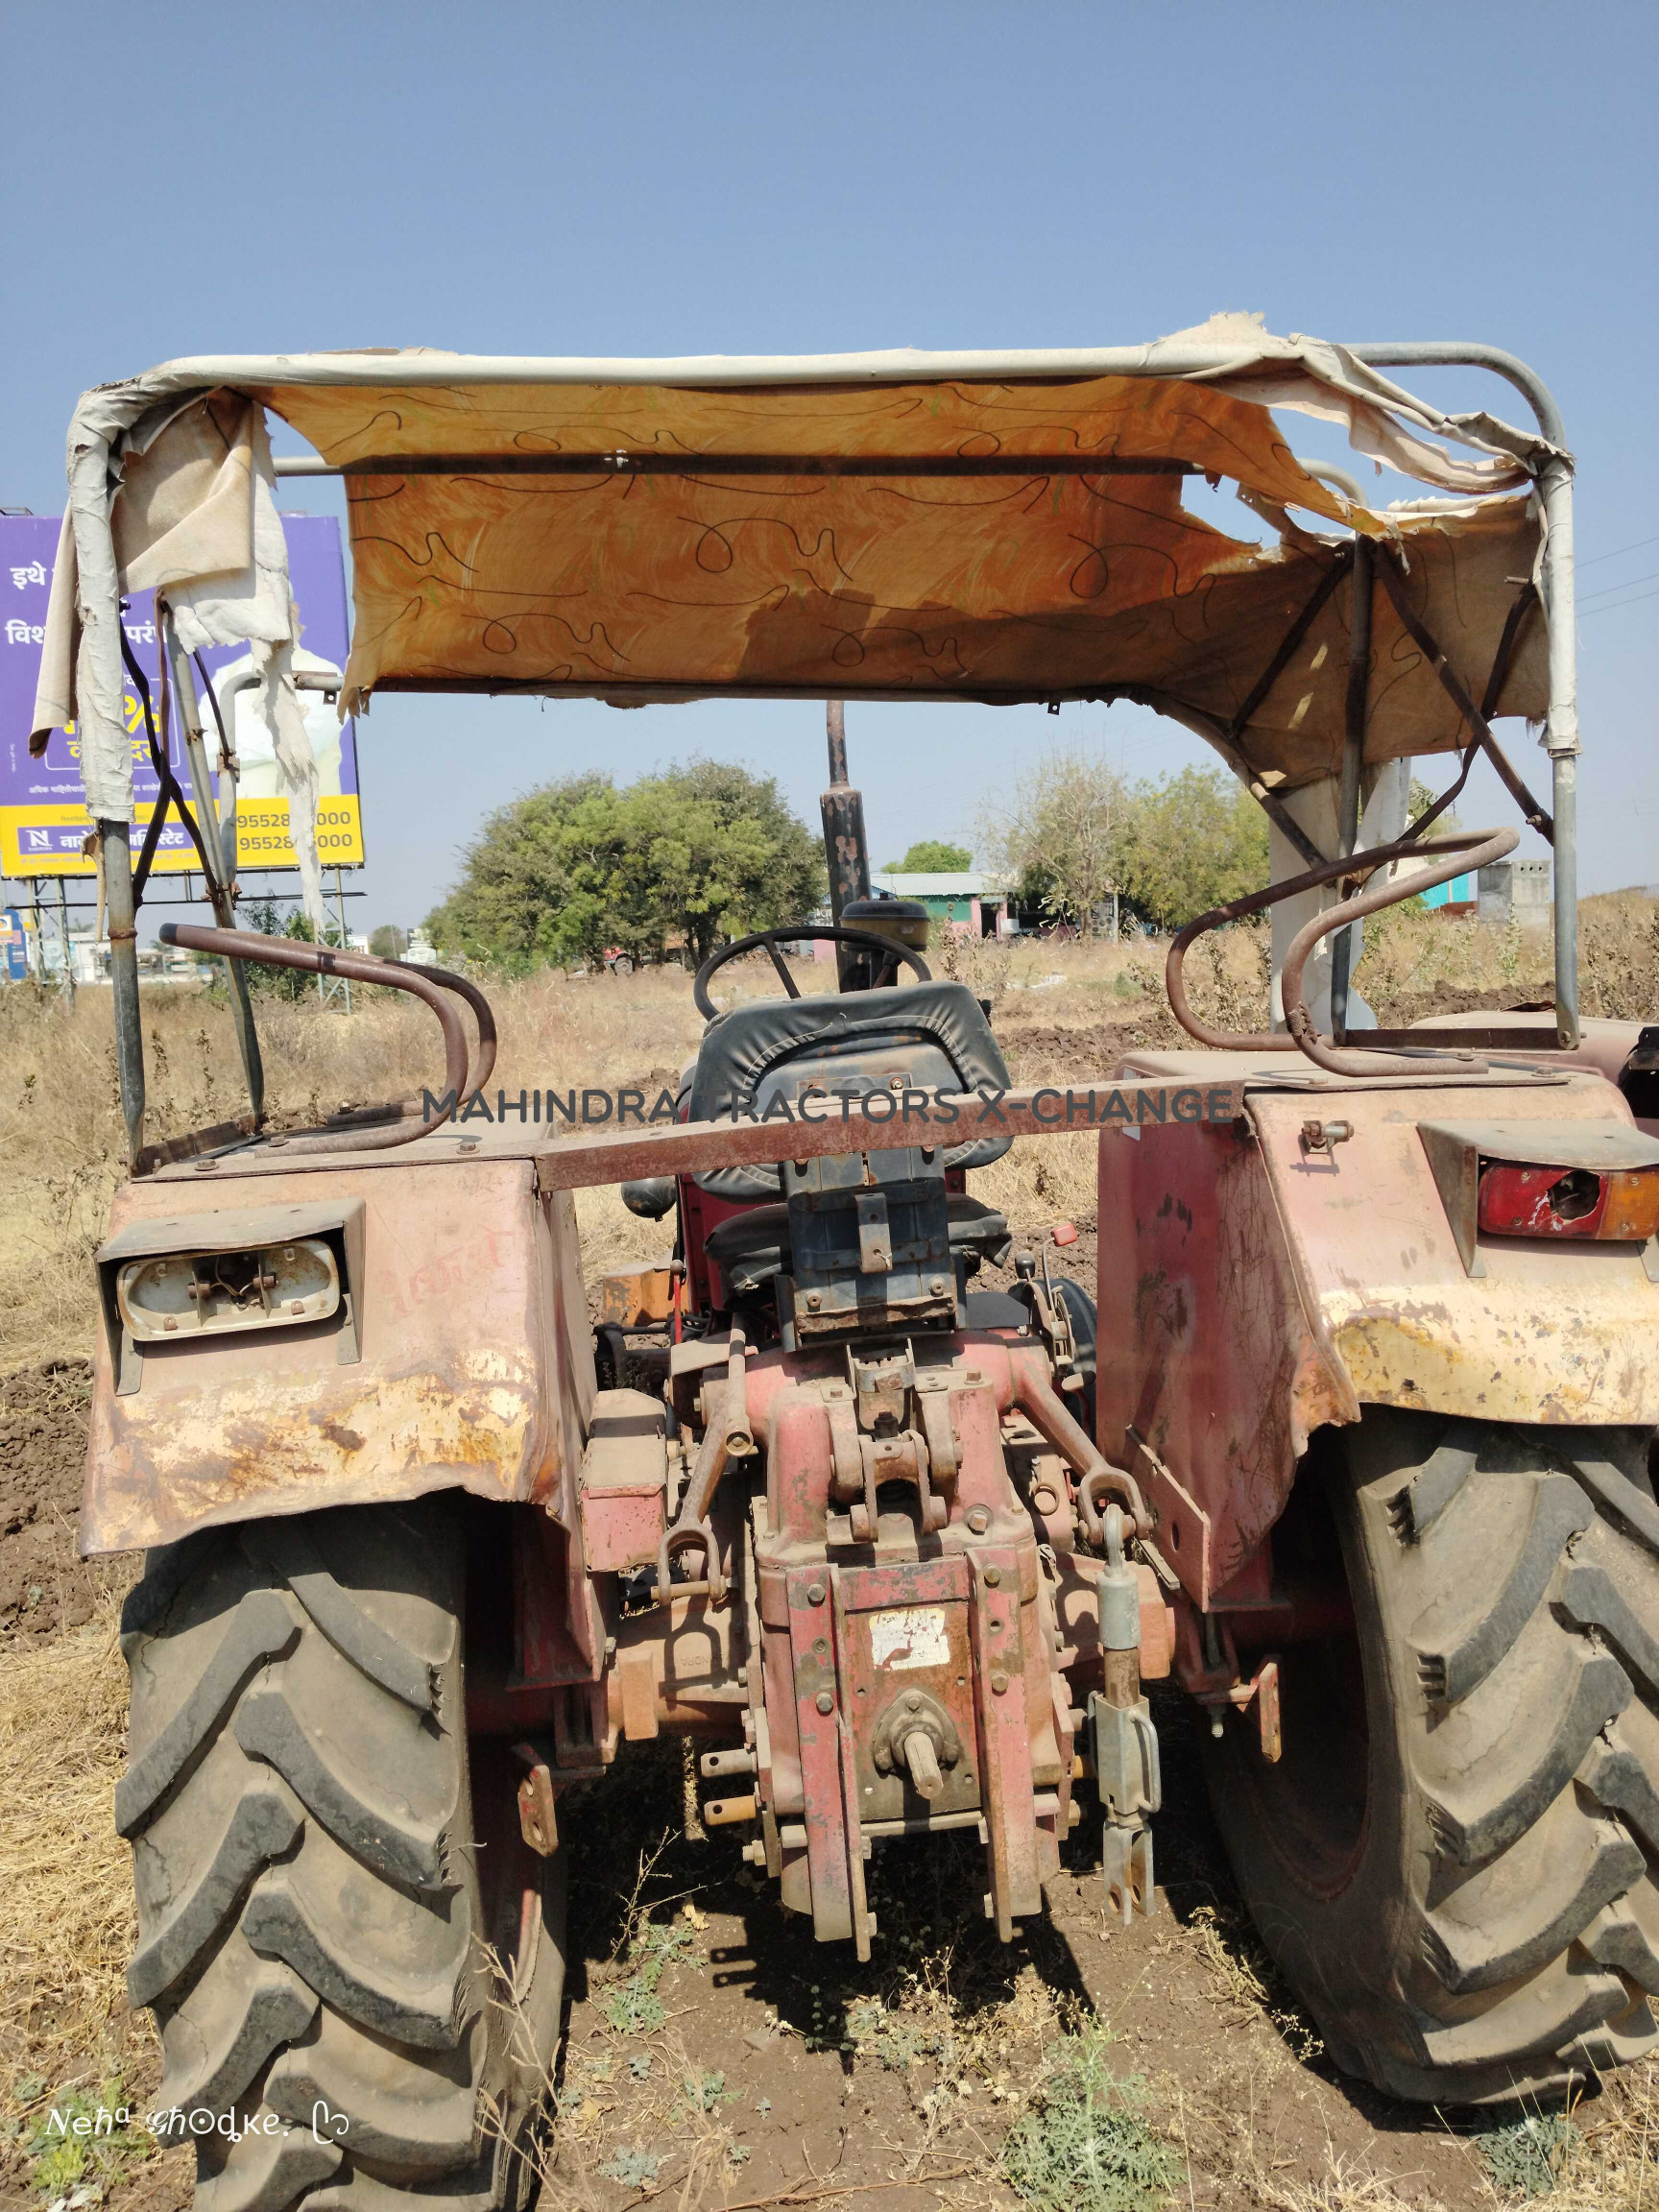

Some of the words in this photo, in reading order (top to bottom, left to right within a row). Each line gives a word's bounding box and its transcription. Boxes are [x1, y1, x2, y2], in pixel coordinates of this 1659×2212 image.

[10, 561, 46, 589] इथे
[237, 811, 351, 829] 95528000
[239, 833, 352, 851] 95528000
